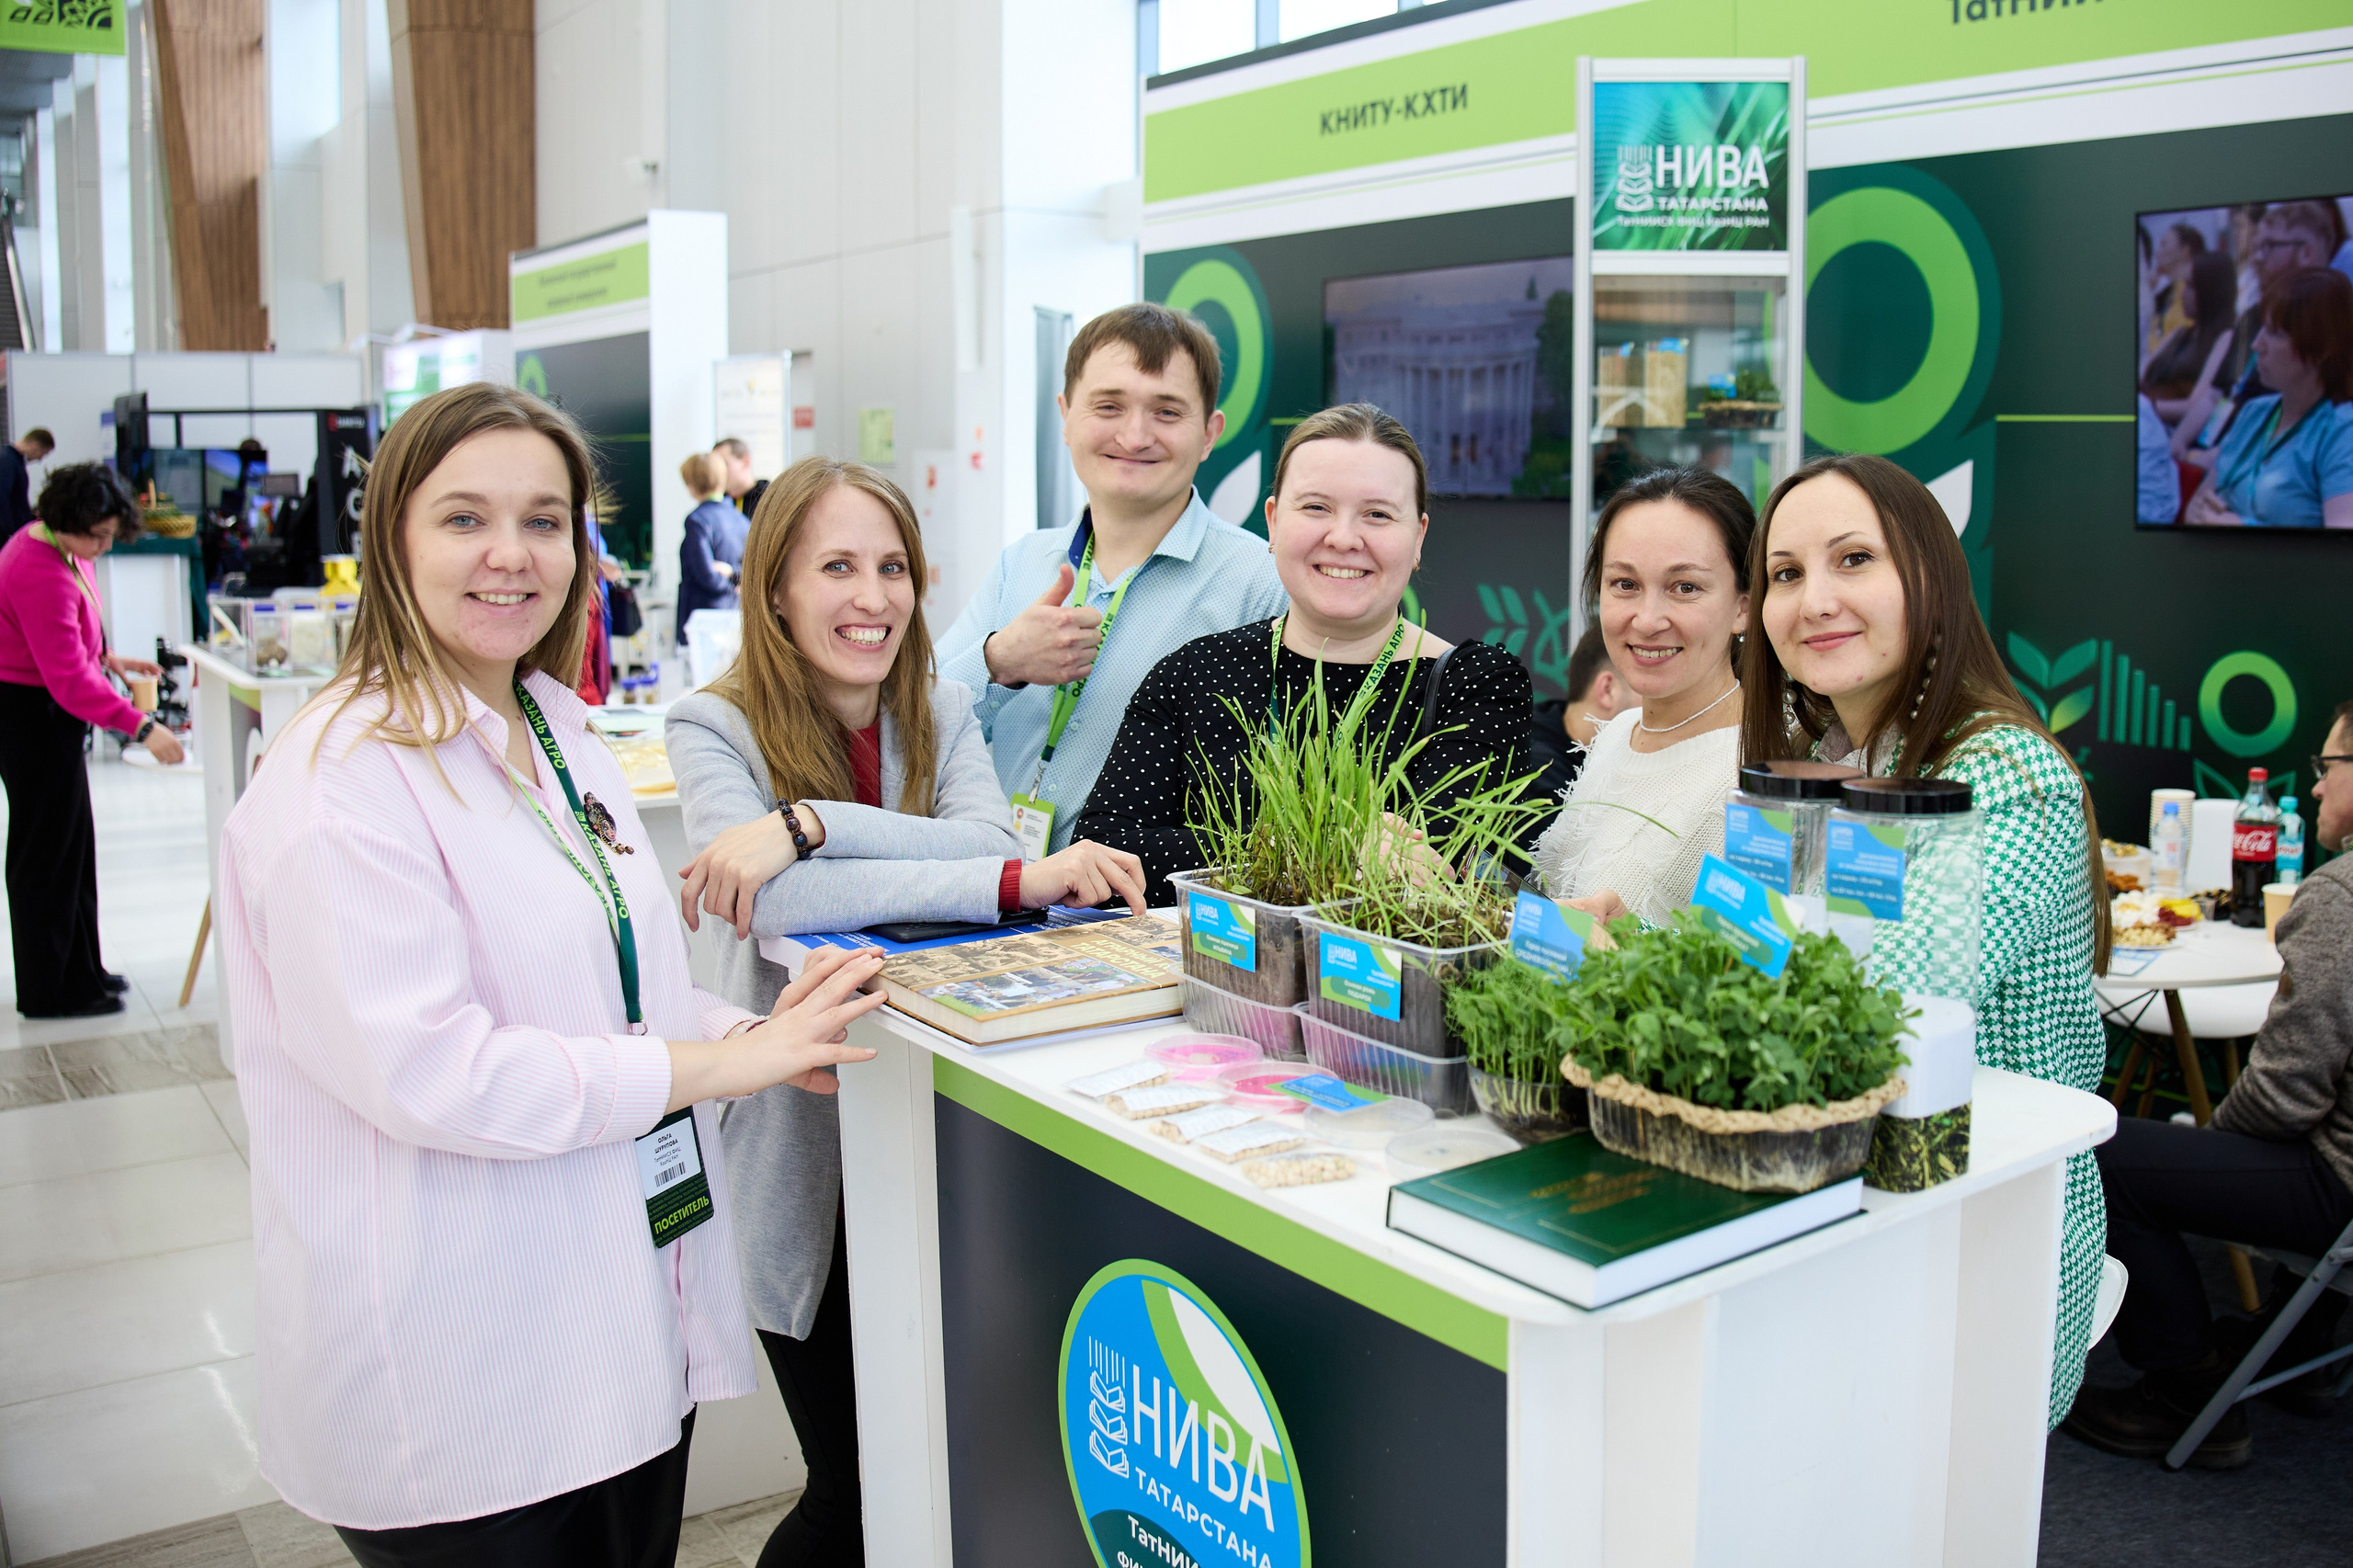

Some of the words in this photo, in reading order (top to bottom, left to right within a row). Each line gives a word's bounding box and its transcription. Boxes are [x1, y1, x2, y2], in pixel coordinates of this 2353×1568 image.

[1321, 84, 1467, 136] КНИТУ-КХТИ
[1655, 144, 1769, 189] НИВА
[1658, 196, 1769, 212] ТАТАРСТАНА
[1366, 650, 1394, 690] КАЗАНЬ
[1389, 623, 1404, 650] АГРО
[515, 684, 548, 735] КАЗАНЬ
[540, 737, 566, 770] АГРО
[581, 823, 612, 878] КАЗАНЬ
[609, 879, 630, 919] АГРО
[1200, 903, 1219, 920] НИВА
[1070, 941, 1167, 979] ТАТАРСТАНА
[1091, 938, 1165, 964] АГРАРНЫЙ
[1335, 945, 1358, 964] НИВА
[654, 1195, 710, 1235] ПОСЕТИТЕЛЬ
[1132, 1363, 1275, 1533] НИВА
[1135, 1467, 1272, 1568] ТАТАРСТАНА
